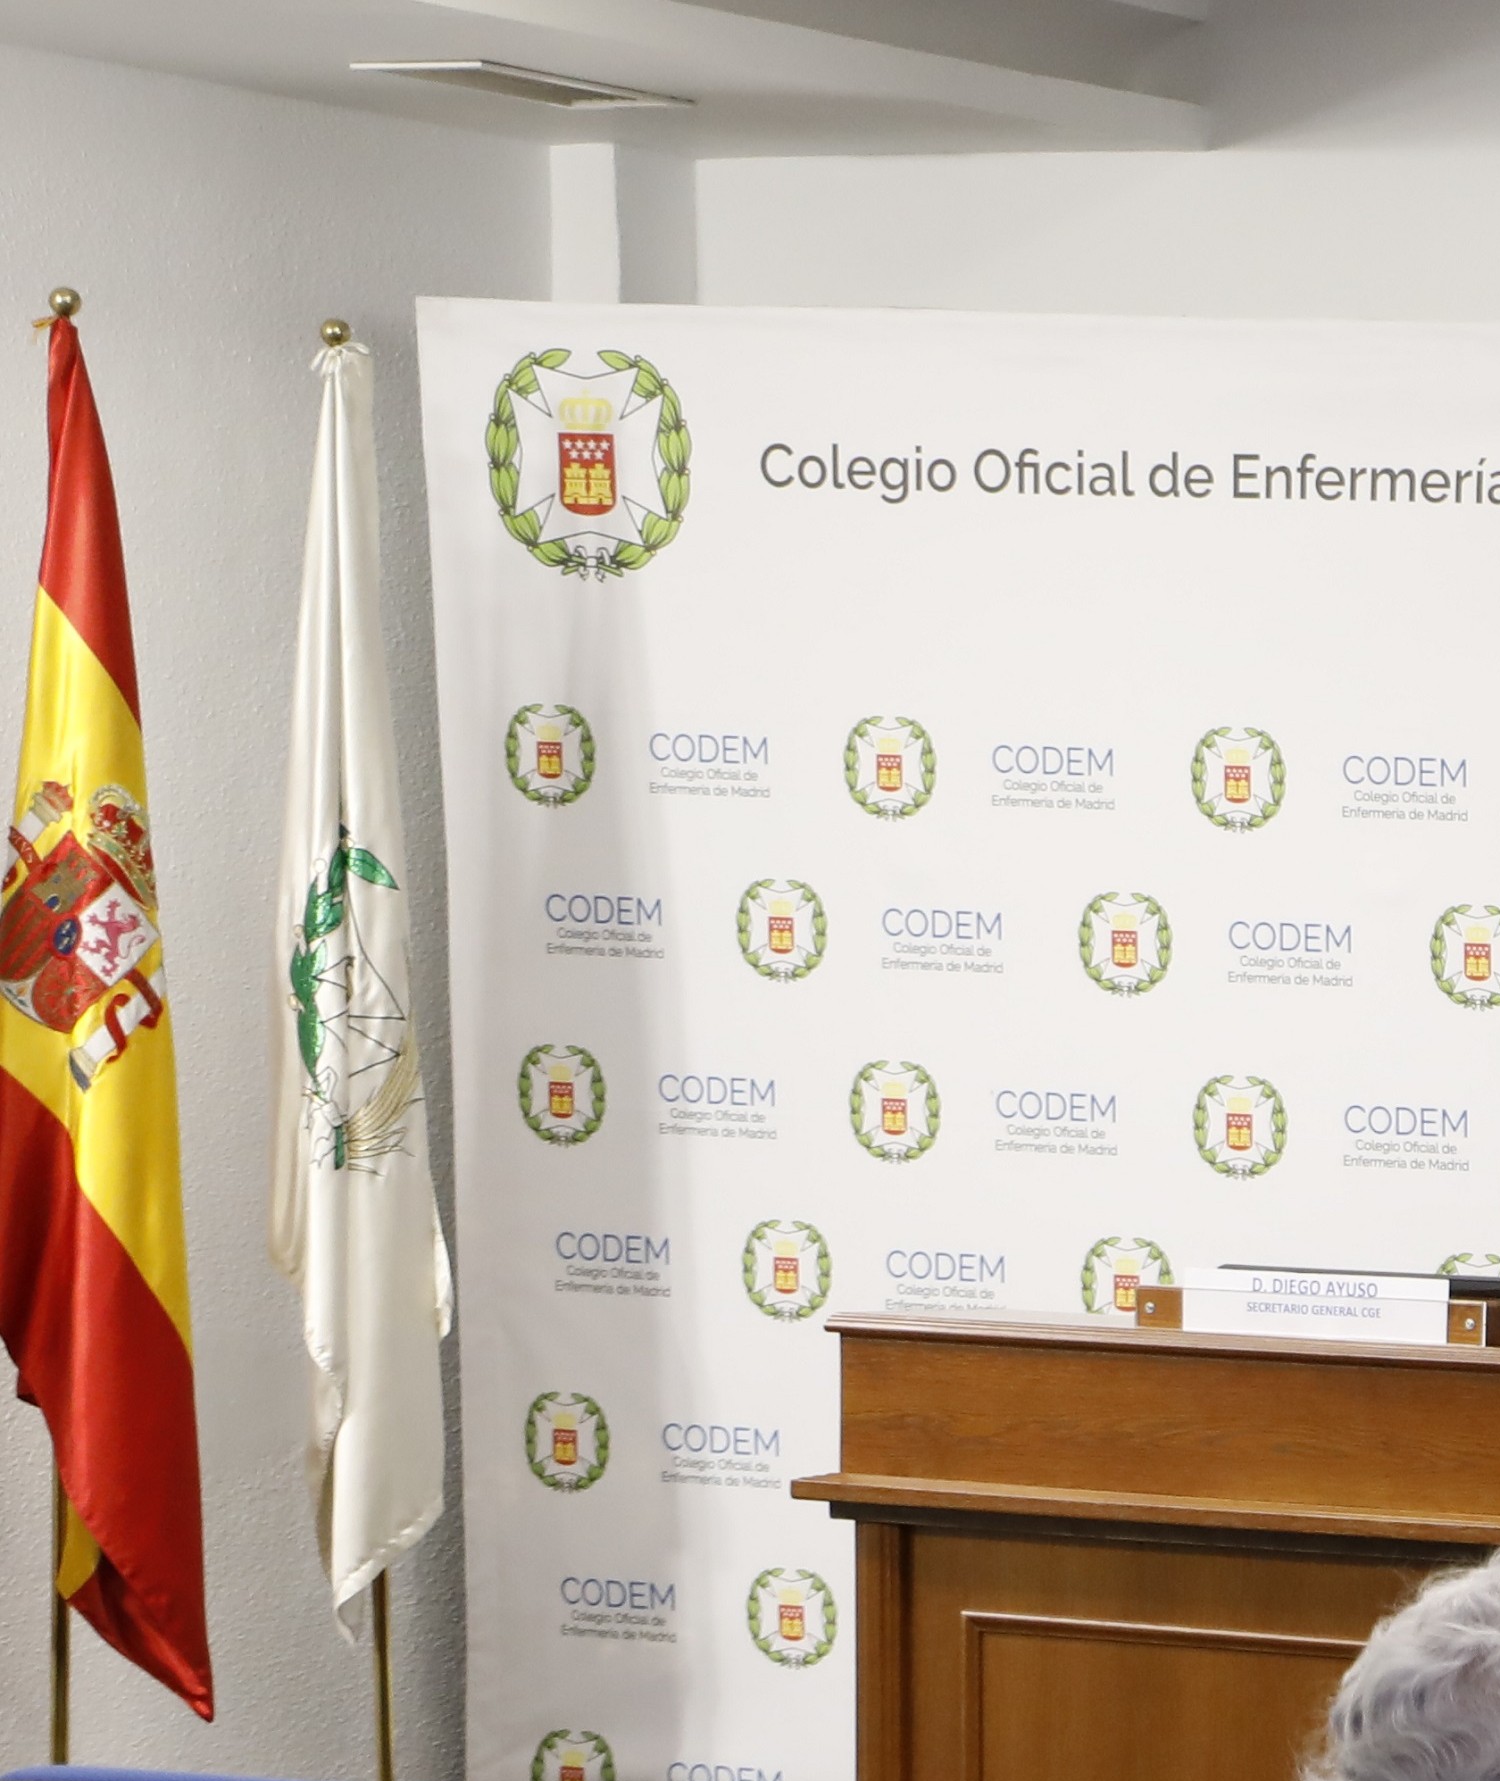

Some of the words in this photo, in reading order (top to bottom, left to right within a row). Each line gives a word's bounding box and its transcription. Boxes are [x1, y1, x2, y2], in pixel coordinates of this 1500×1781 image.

[760, 443, 957, 504] Colegio
[974, 447, 1136, 498] Oficial
[1149, 450, 1214, 499] de
[650, 733, 768, 764] CODEM
[992, 745, 1113, 776] CODEM
[1343, 756, 1466, 787] CODEM
[1353, 790, 1399, 806] Colegio
[1401, 791, 1438, 804] Oficial
[1440, 792, 1456, 804] de
[1408, 808, 1424, 820] de
[1427, 809, 1468, 821] Madrid
[545, 894, 662, 925] CODEM
[882, 908, 1001, 939] CODEM
[1229, 921, 1351, 953] CODEM
[1239, 956, 1284, 971] Colegio
[1287, 956, 1323, 970] Oficial
[1325, 958, 1341, 970] de
[1294, 974, 1309, 986] de
[1313, 975, 1353, 987] Madrid
[659, 1074, 775, 1106] CODEM
[996, 1090, 1116, 1122] CODEM
[1344, 1105, 1468, 1137] CODEM
[1355, 1140, 1400, 1156] Colegio
[1403, 1141, 1440, 1155] Oficial
[1442, 1142, 1458, 1155] de
[1410, 1159, 1425, 1171] de
[1429, 1159, 1470, 1172] Madrid
[556, 1232, 669, 1265] CODEM
[886, 1250, 1005, 1283] CODEM
[1251, 1277, 1267, 1294] D.
[1272, 1278, 1321, 1296] DIEGO
[1325, 1280, 1379, 1298] AYUSO
[1246, 1302, 1309, 1316] SECRETARIO
[1311, 1304, 1359, 1318] GENERAL
[1361, 1306, 1382, 1319] CGE
[662, 1423, 779, 1456] CODEM
[561, 1577, 675, 1610] CODEM
